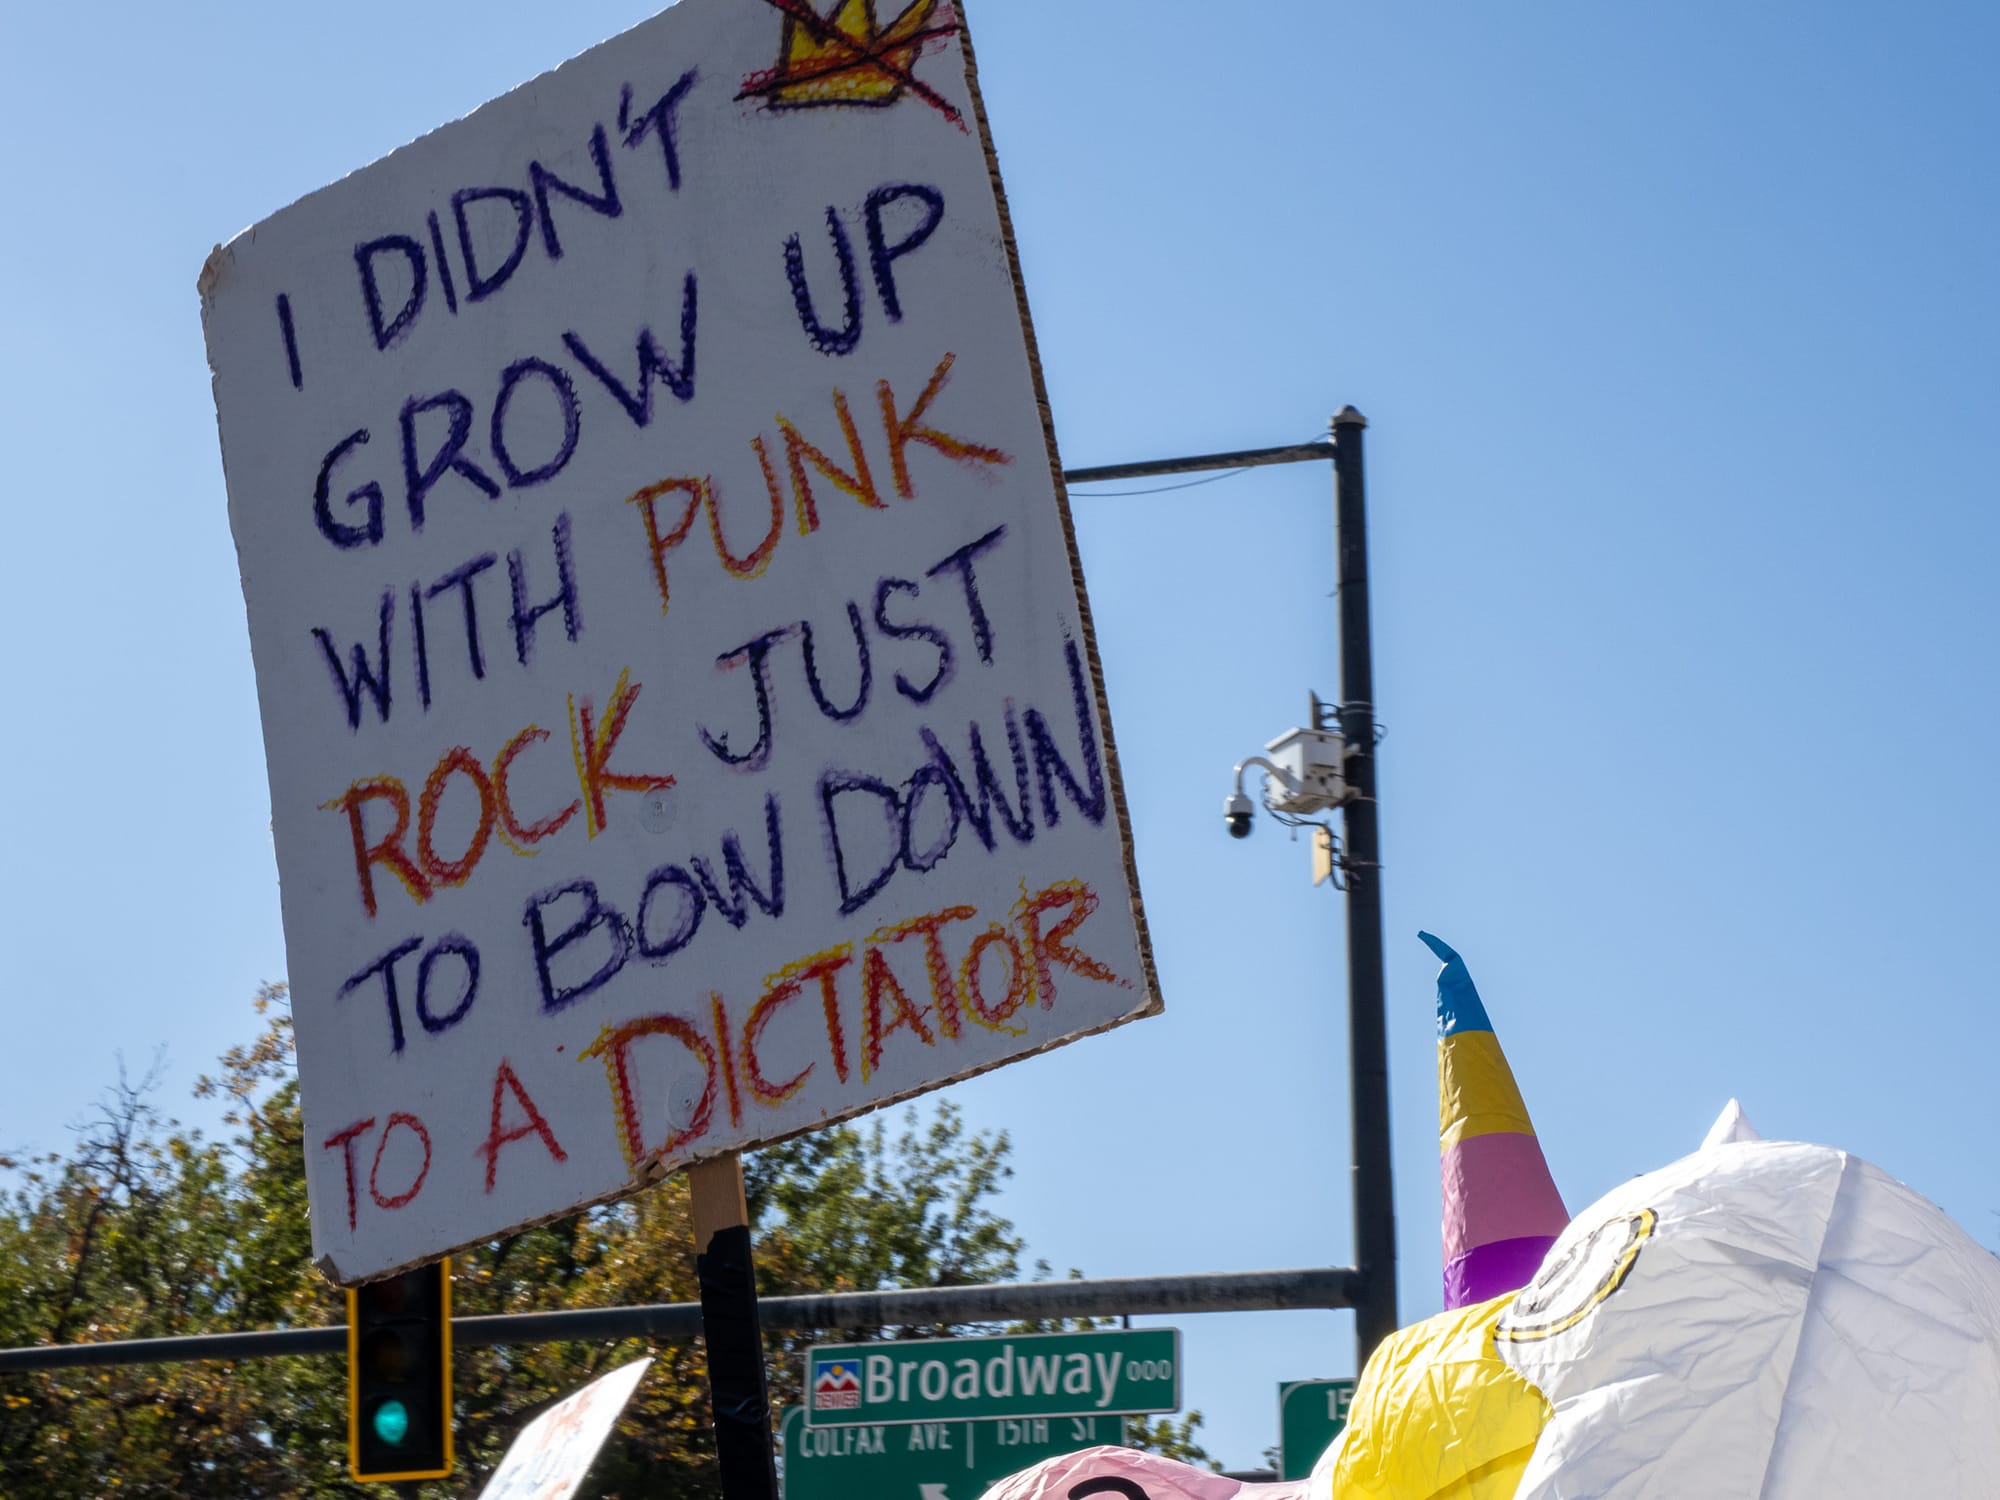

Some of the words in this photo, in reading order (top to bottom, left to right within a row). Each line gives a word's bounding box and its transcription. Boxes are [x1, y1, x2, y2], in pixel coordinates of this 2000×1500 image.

[277, 294, 303, 390] I
[354, 67, 699, 350] DIDN'T
[314, 270, 698, 549] GROW
[783, 183, 944, 356] UP
[311, 512, 583, 733] WITH
[626, 352, 1012, 614] PUNK
[317, 665, 677, 919] ROCK
[698, 524, 1007, 772] JUST
[338, 930, 481, 1055] TO
[523, 790, 786, 1012] BOW
[817, 632, 1106, 916] DOWN
[324, 1109, 433, 1231] TO
[476, 1056, 569, 1194] A
[578, 876, 1135, 1178] DICTATOR
[799, 1425, 887, 1458] COLFAX
[908, 1422, 953, 1451] AVE
[865, 1344, 1123, 1407] Broadway
